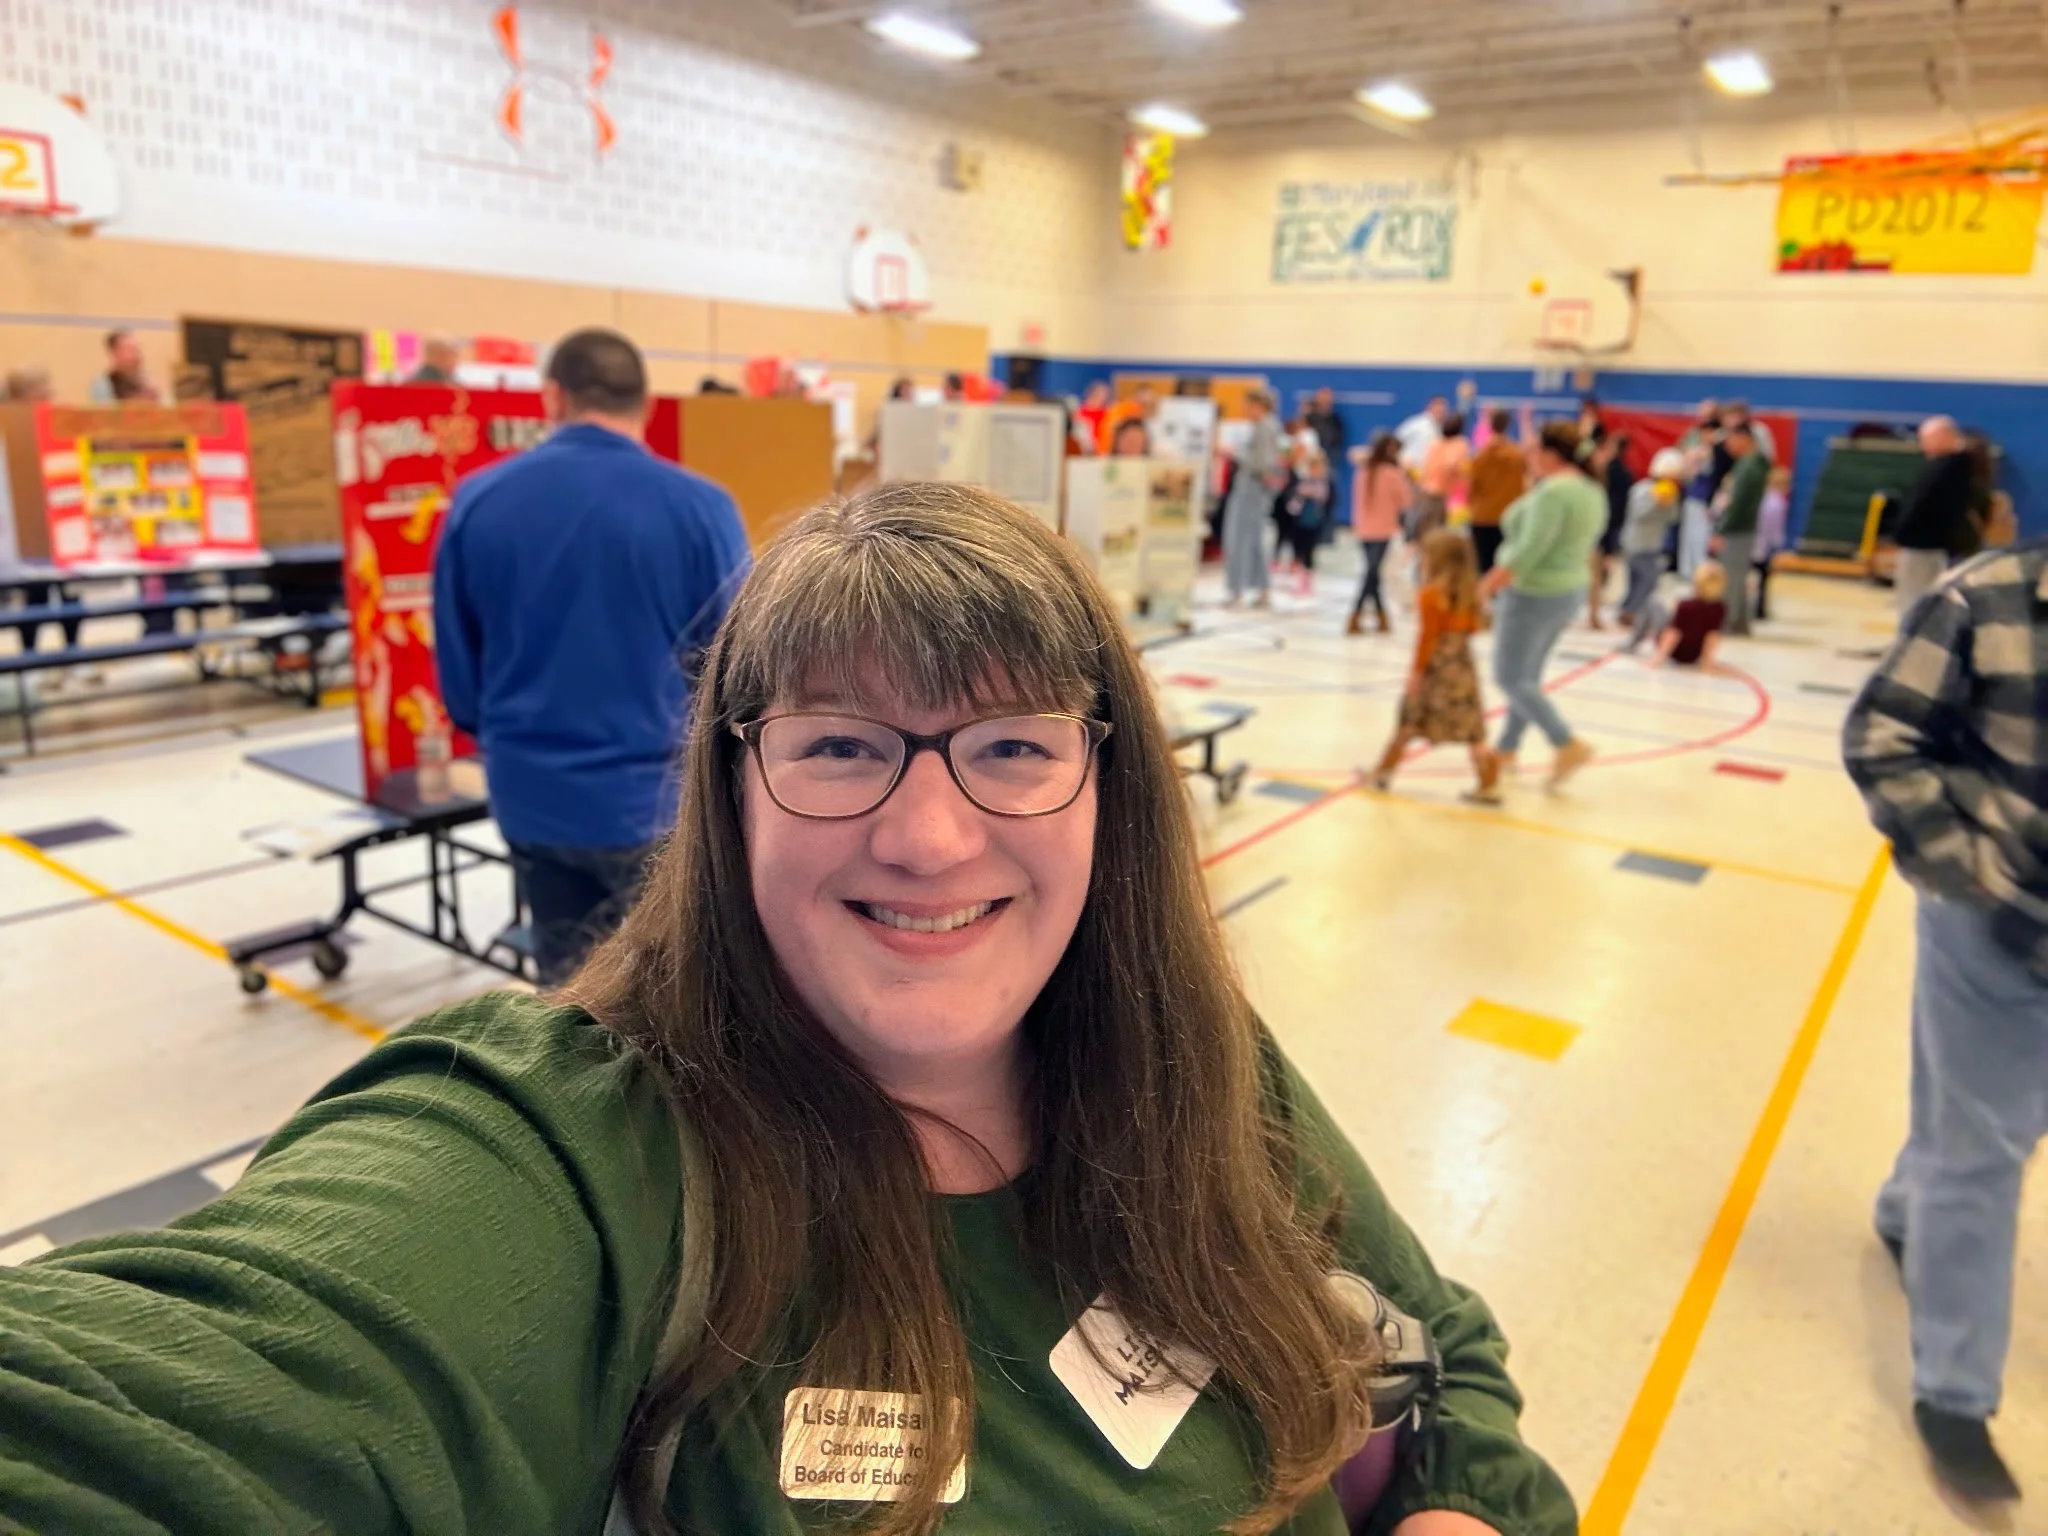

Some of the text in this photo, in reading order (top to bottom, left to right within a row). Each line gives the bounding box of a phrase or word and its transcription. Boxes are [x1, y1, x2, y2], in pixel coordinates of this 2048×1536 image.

[803, 1403, 926, 1430] Lisa Maisa
[820, 1439, 904, 1458] Candidate
[795, 1466, 845, 1484] Board
[851, 1469, 867, 1485] of
